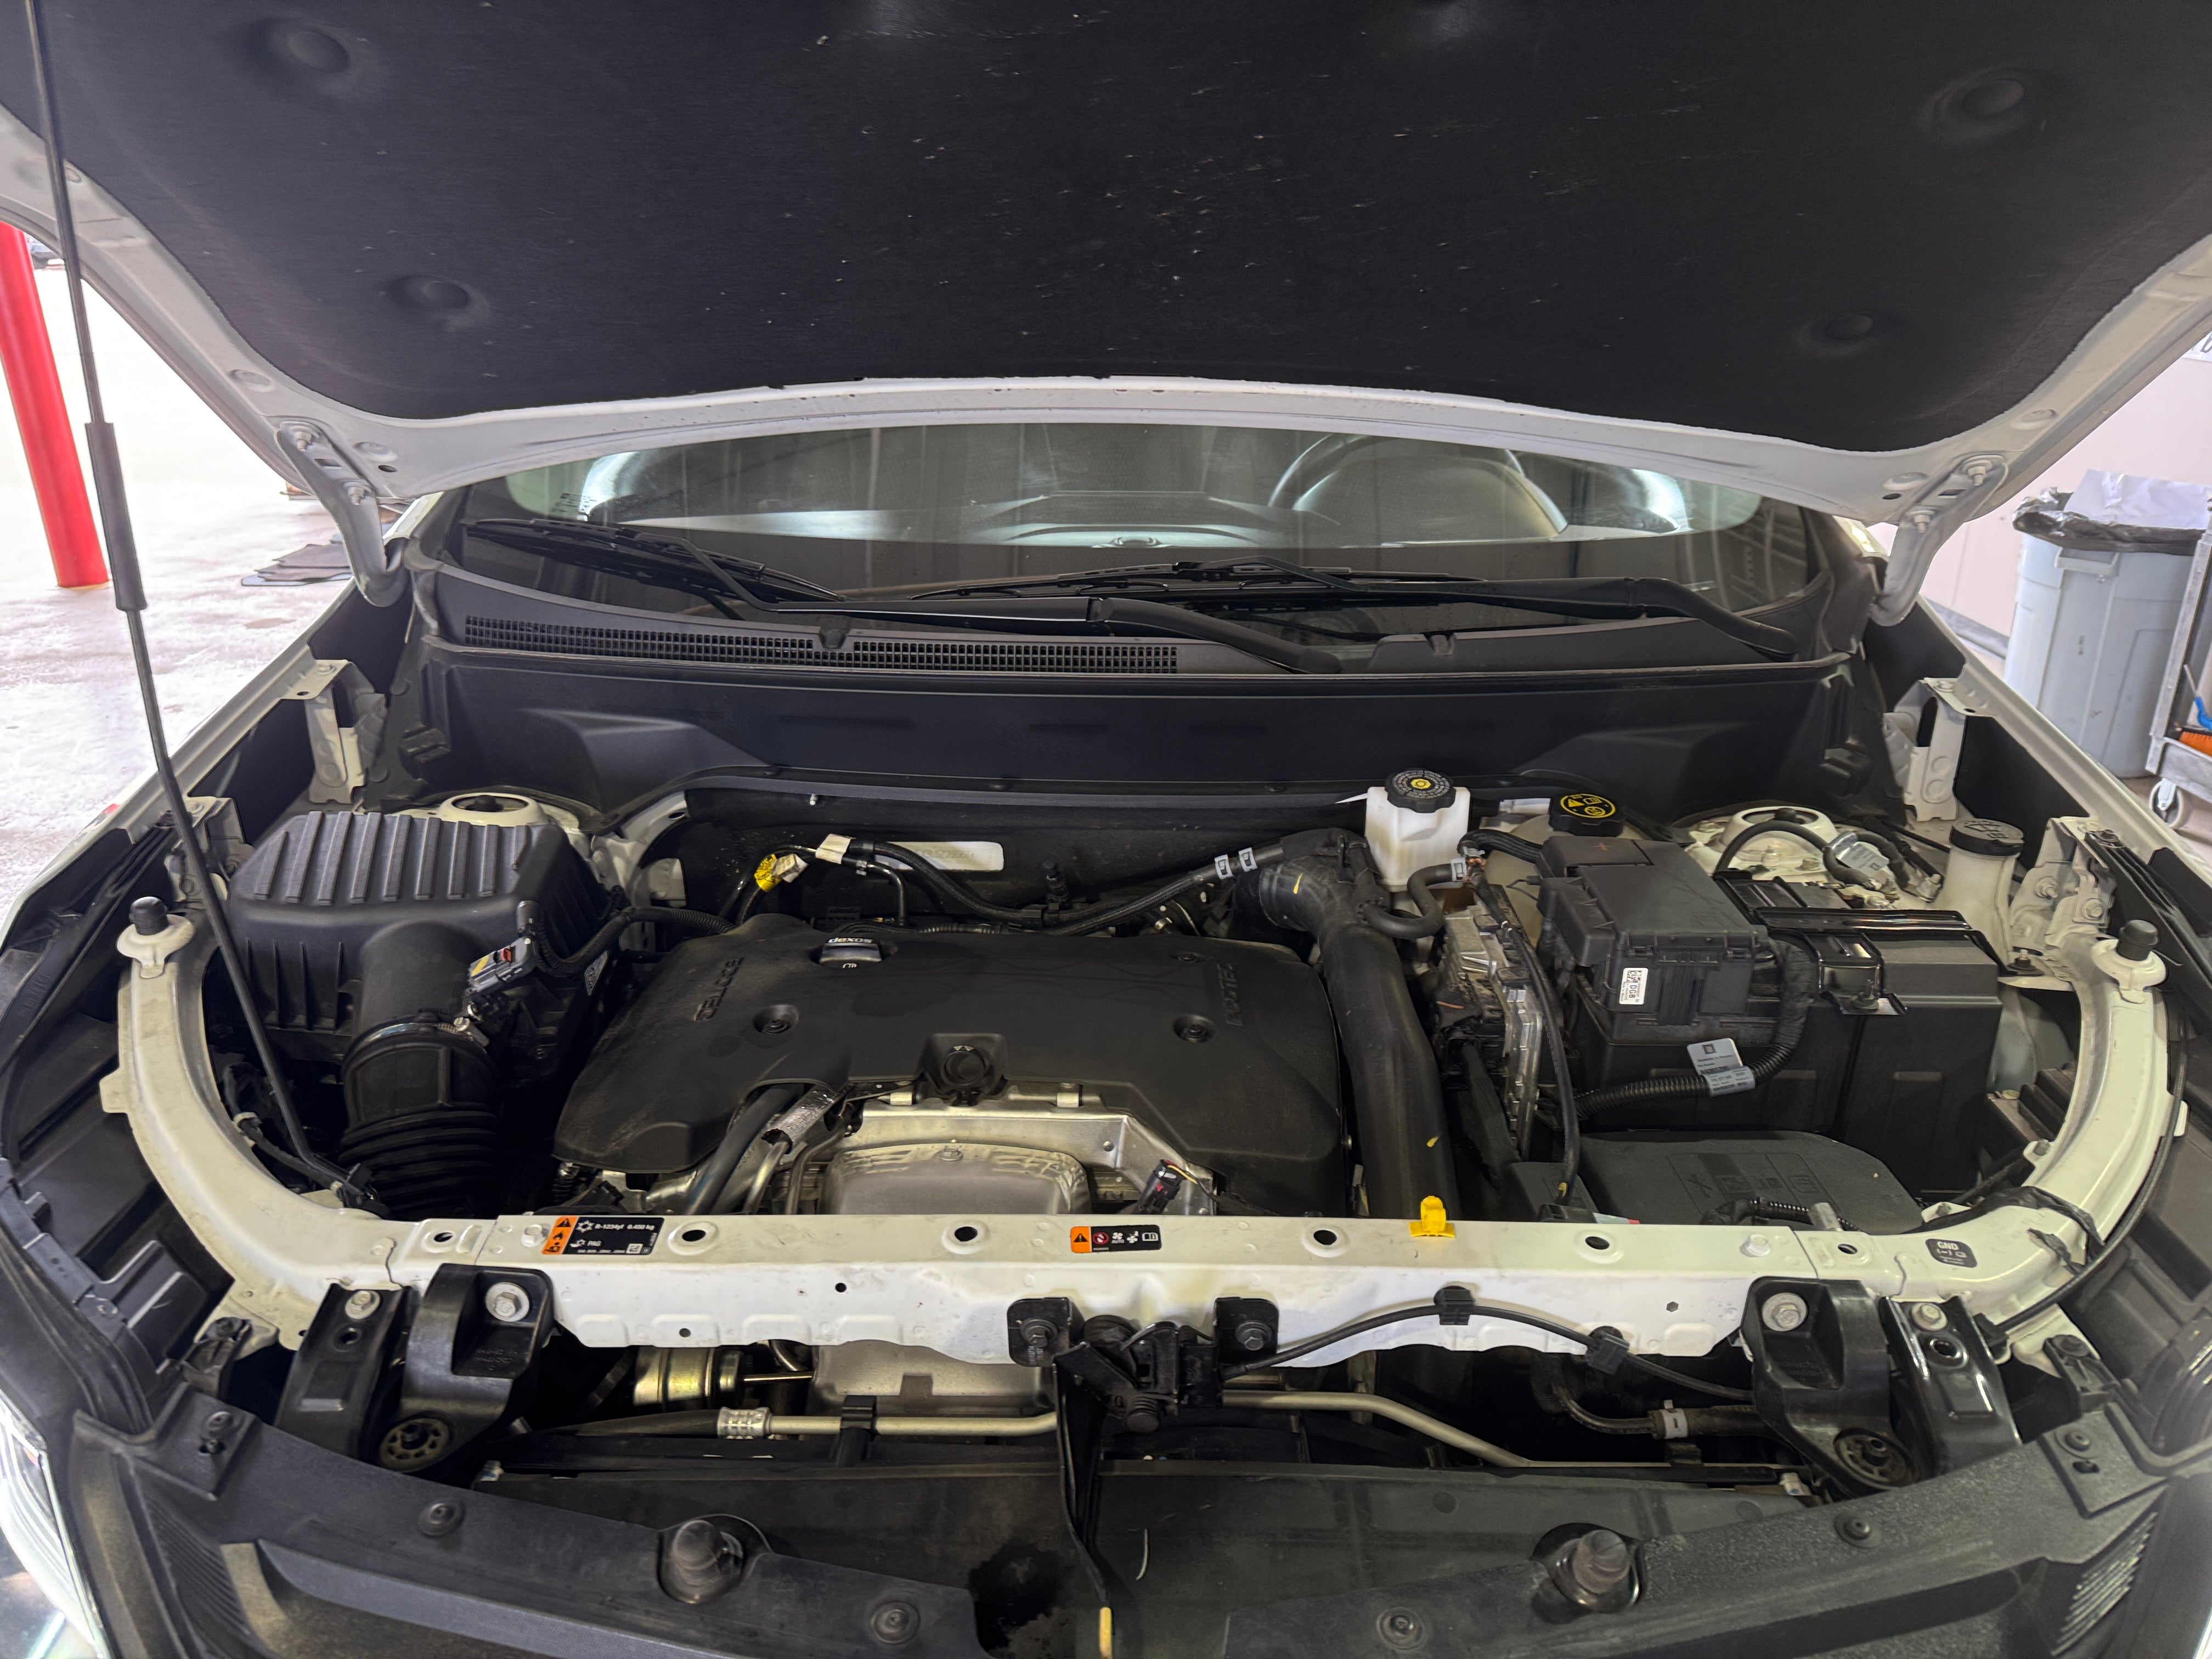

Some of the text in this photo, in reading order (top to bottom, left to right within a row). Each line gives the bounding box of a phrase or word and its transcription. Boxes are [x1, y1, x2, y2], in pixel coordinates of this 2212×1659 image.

[693, 957, 744, 1021] ECOTEC
[1217, 963, 1243, 1027] ECOTEC
[1937, 1241, 1960, 1251] GND
